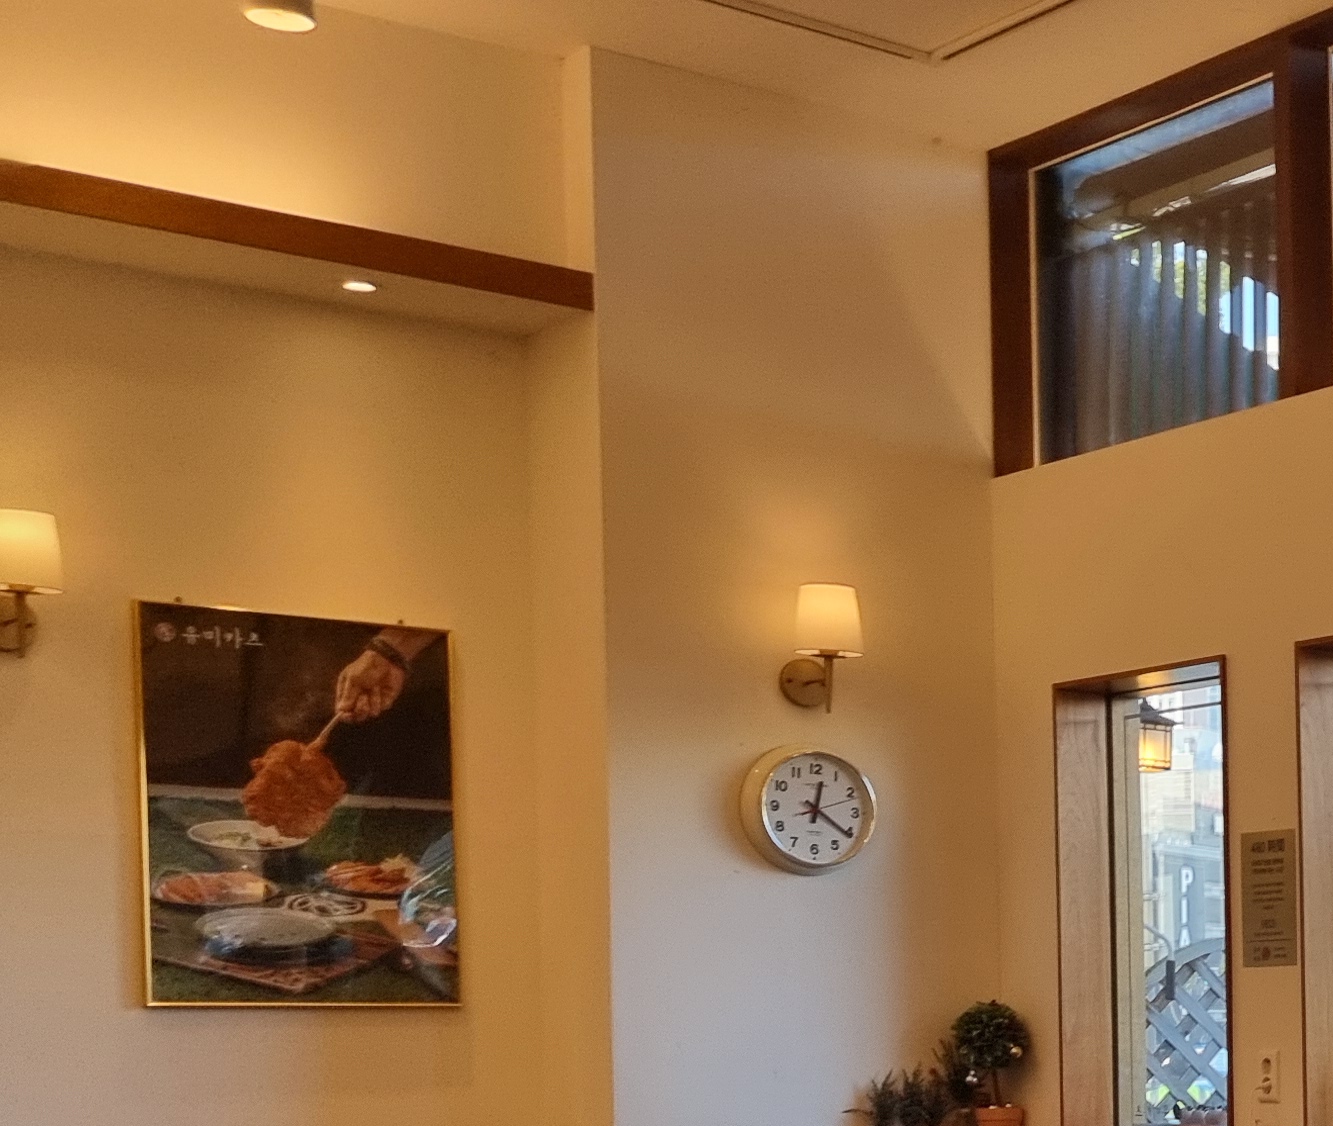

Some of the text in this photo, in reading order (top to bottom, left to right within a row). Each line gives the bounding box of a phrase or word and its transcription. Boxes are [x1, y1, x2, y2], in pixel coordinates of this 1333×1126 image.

[791, 767, 801, 779] 11
[809, 763, 822, 775] 12
[775, 780, 788, 792] 10
[846, 787, 854, 798] 2
[770, 800, 779, 811] 9
[850, 807, 860, 819] 3
[775, 821, 784, 832] 8
[789, 836, 799, 848] 7
[831, 839, 840, 851] 5
[810, 844, 820, 855] 6
